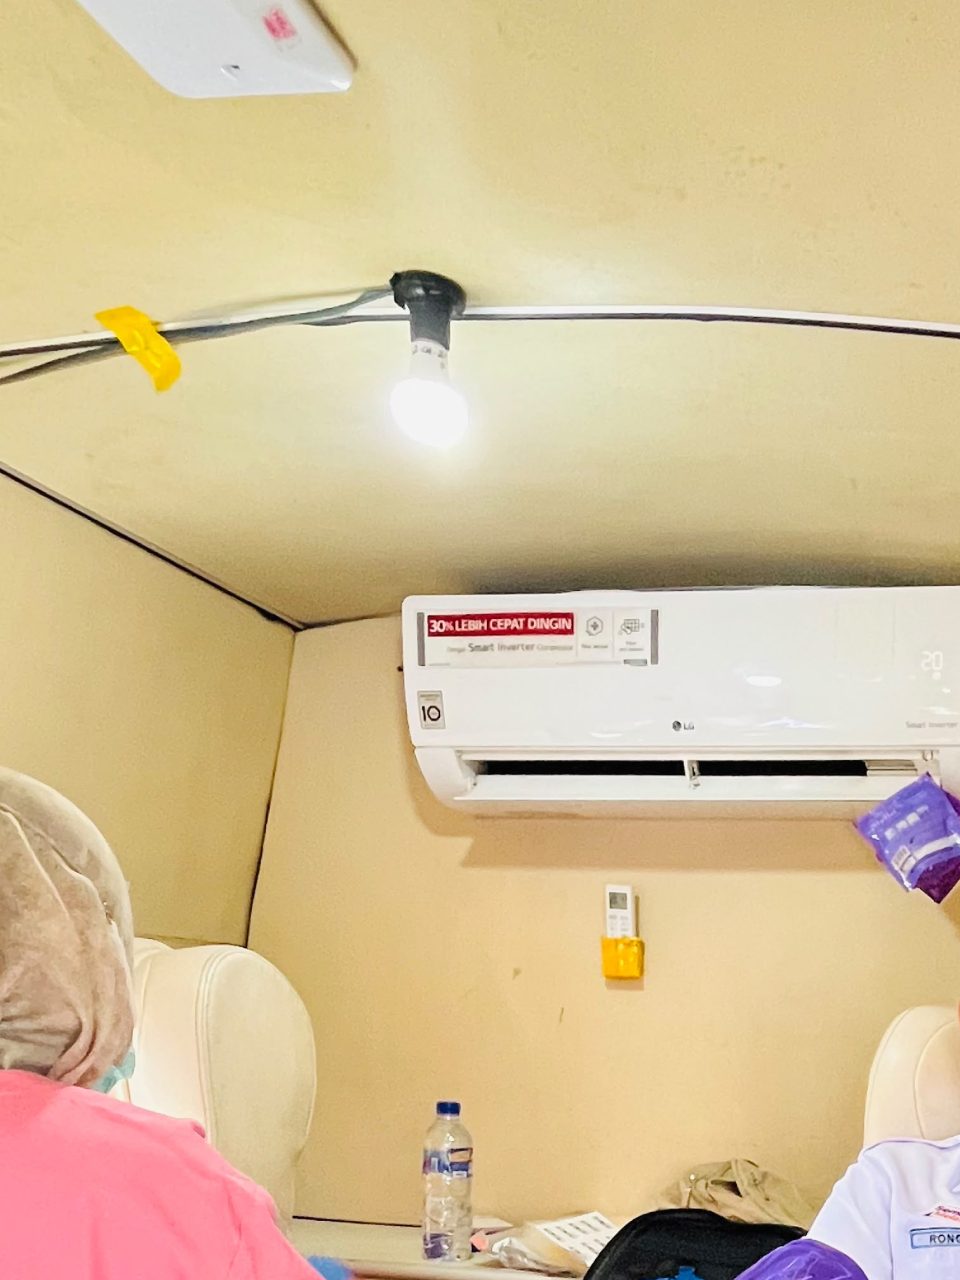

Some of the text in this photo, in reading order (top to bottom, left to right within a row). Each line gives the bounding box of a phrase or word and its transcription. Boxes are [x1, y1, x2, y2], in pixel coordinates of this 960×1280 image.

[429, 617, 572, 633] 30% LEBIH CEPAT DINGIN
[468, 643, 494, 652] Smart
[421, 705, 441, 721] 10
